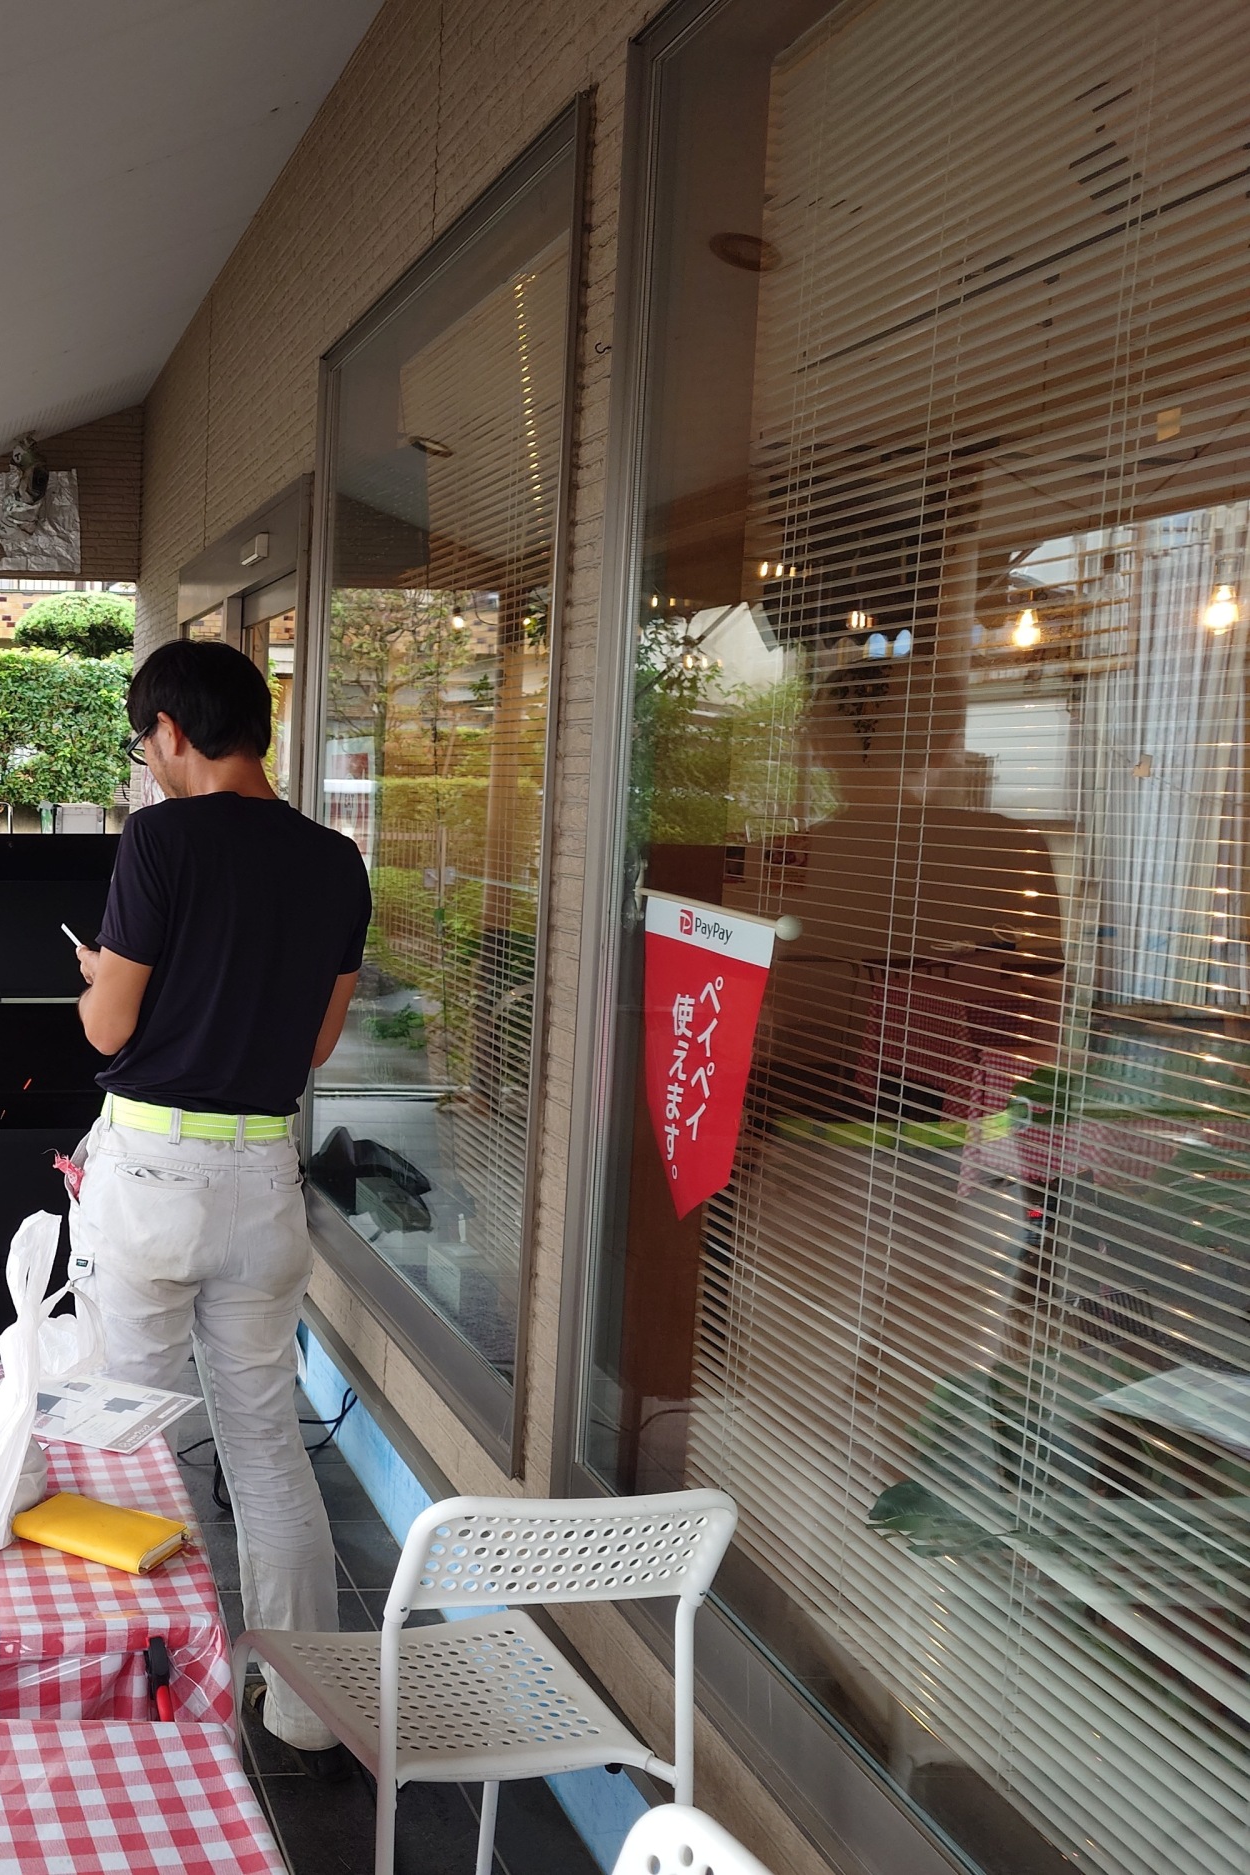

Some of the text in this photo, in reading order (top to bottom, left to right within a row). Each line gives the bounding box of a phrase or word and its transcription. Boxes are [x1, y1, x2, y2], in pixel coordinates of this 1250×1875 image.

[695, 917, 733, 946] PayPay
[664, 993, 696, 1180] 使えます。
[685, 976, 724, 1142] ペイペイ
